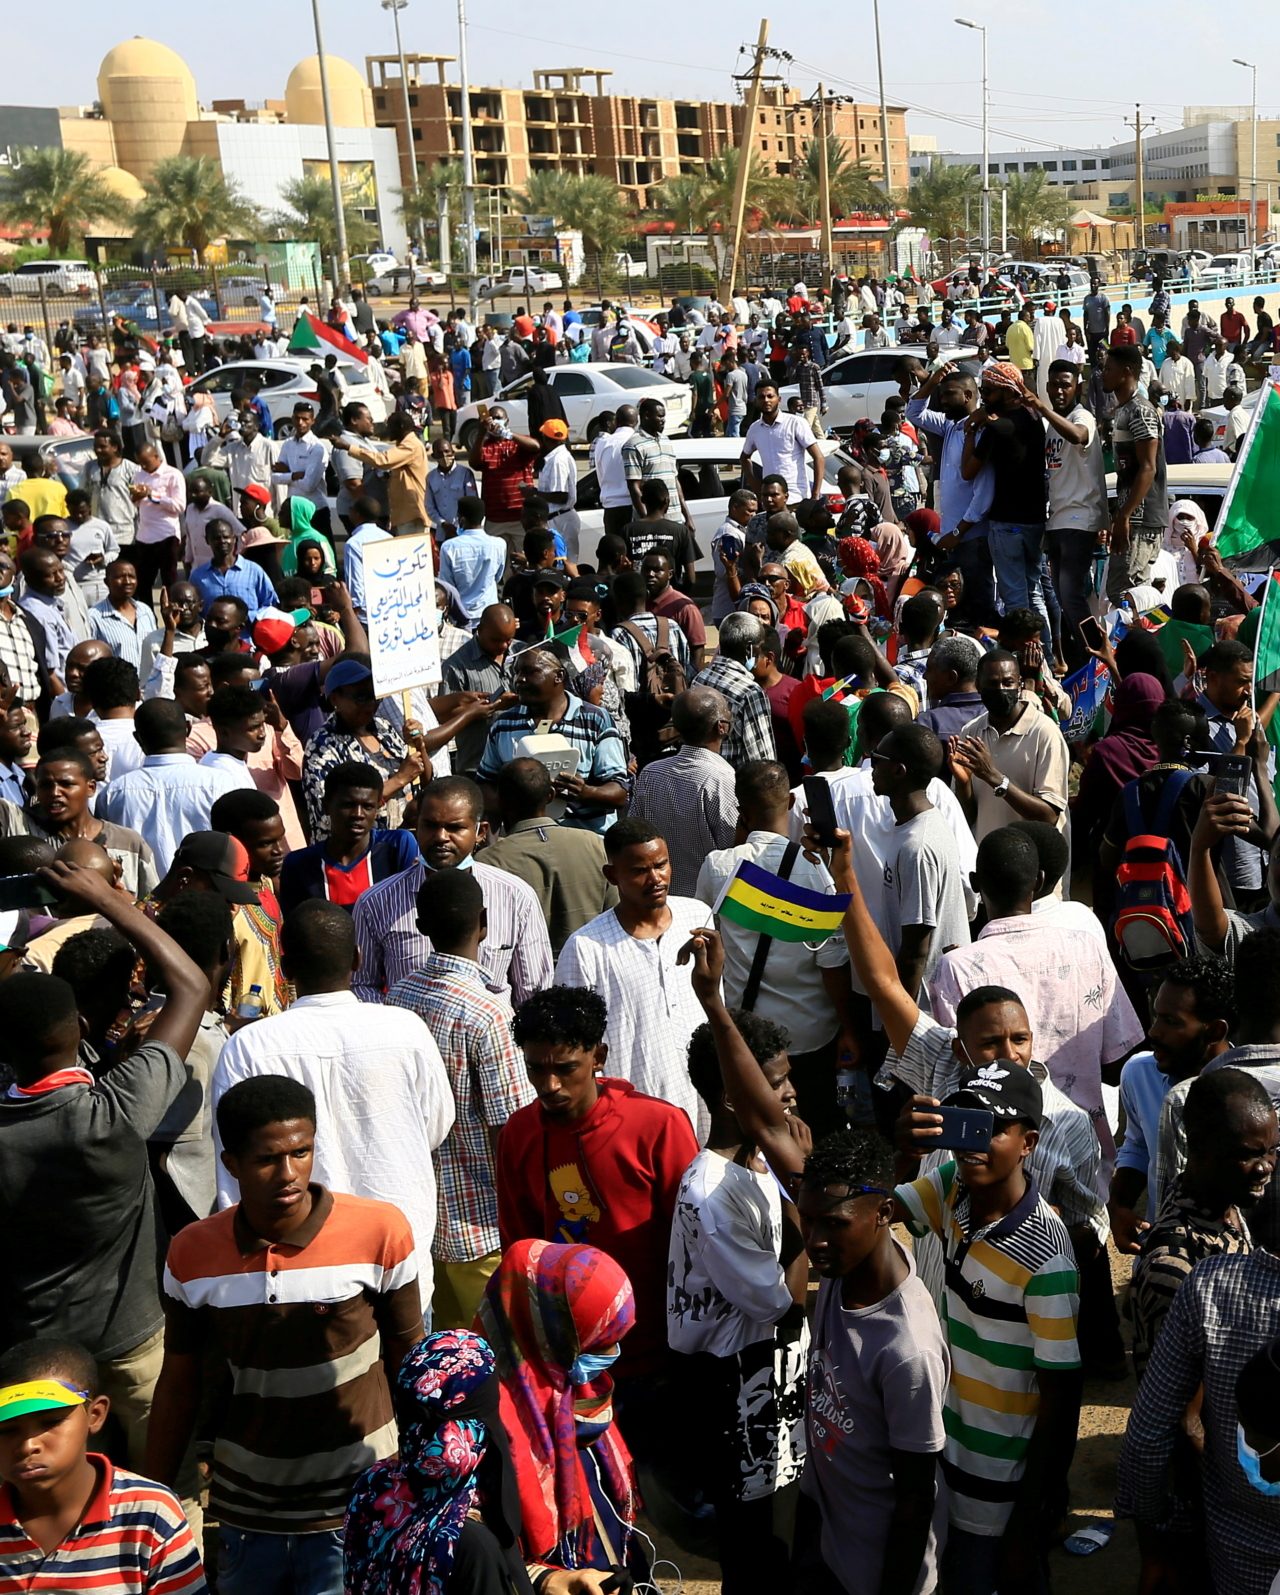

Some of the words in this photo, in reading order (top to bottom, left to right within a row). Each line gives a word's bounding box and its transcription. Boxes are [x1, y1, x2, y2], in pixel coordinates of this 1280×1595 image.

[373, 543, 428, 581] تكوين
[397, 582, 428, 619] المجلس
[403, 617, 434, 651] مطلب
[967, 1080, 1003, 1092] adidas
